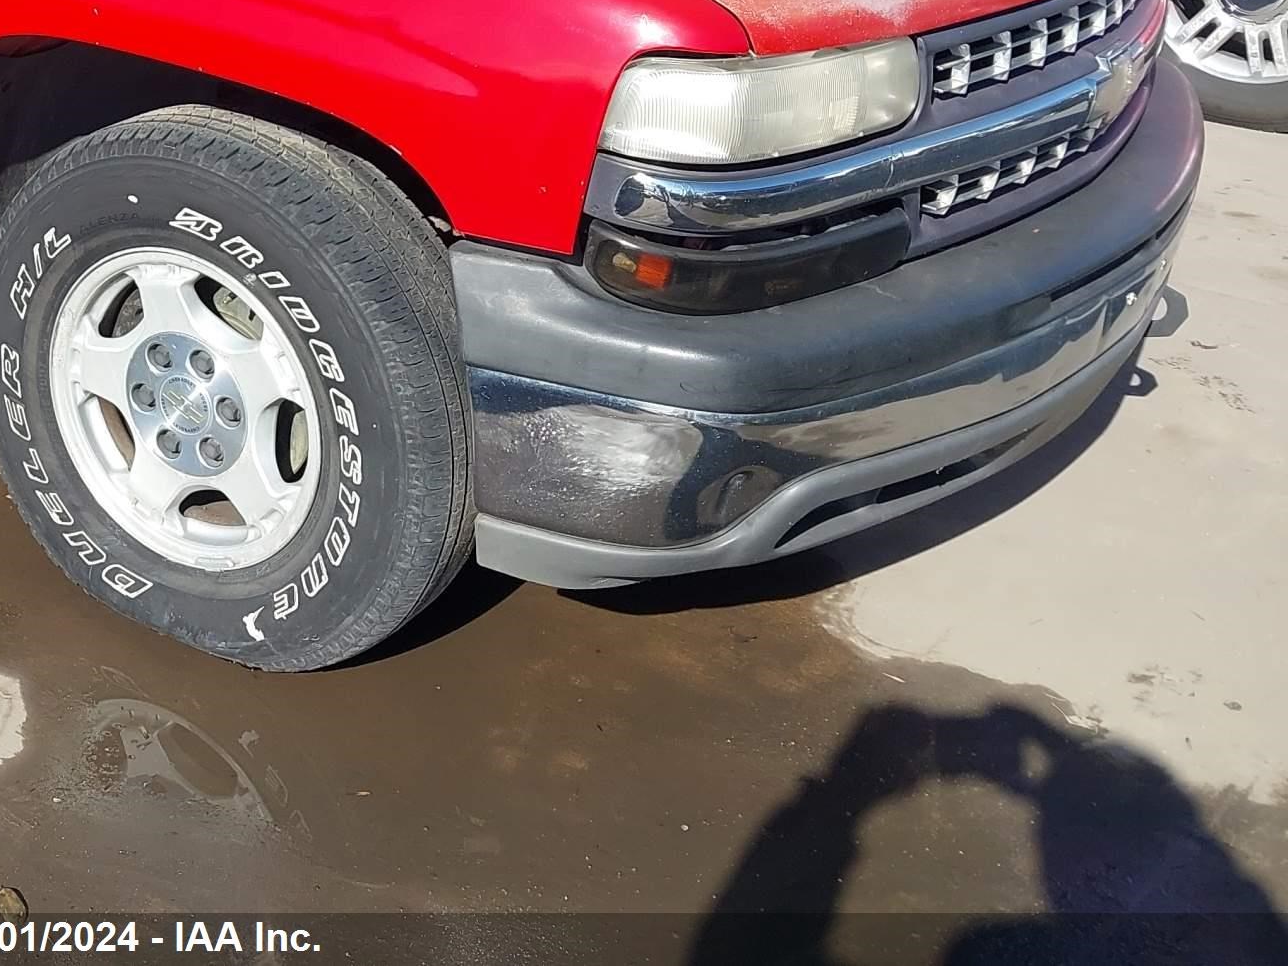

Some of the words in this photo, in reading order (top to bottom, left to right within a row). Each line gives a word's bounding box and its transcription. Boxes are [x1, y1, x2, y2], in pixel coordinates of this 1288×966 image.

[8, 225, 73, 321] H/L
[1, 344, 155, 600] DUELER
[168, 207, 363, 620] BRIDGESTONE
